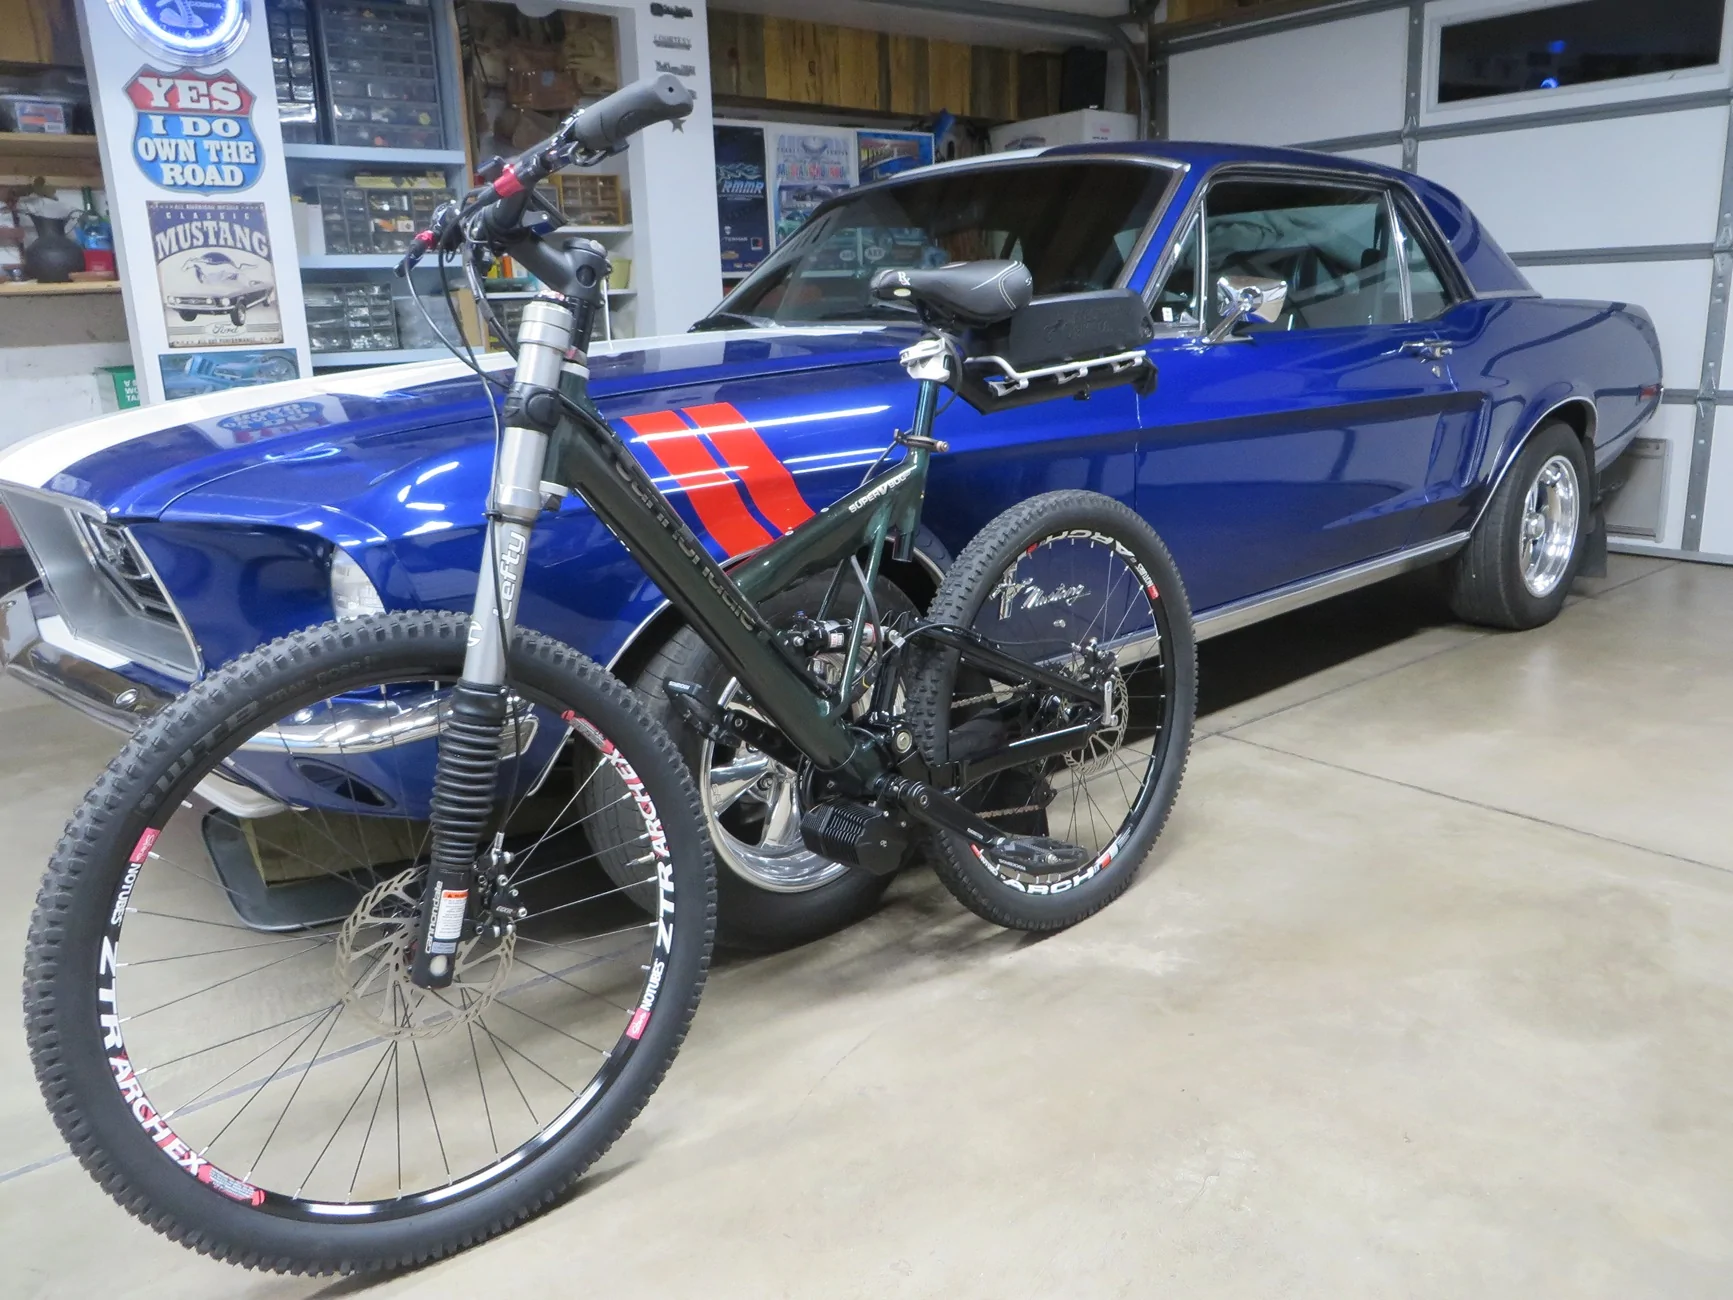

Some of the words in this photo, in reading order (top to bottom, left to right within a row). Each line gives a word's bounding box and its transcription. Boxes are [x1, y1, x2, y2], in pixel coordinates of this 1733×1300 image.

[137, 76, 242, 112] YES
[148, 115, 167, 135] I
[181, 116, 241, 138] DO
[137, 137, 196, 163] OWN
[203, 140, 257, 164] THE
[160, 163, 244, 187] ROAD
[166, 211, 250, 220] CLASSIC
[155, 220, 269, 260] MUSTANG
[211, 323, 239, 335] Ford
[848, 488, 880, 513] SUPER
[493, 531, 526, 620] Lefty
[1020, 583, 1091, 609] Mustang
[111, 863, 141, 925] NOTUBES
[425, 881, 443, 954] cannondale
[641, 960, 665, 1012] NOTUBES
[656, 861, 675, 954] ZTR
[99, 935, 124, 1049] ZTR
[108, 1055, 171, 1149] ARCH
